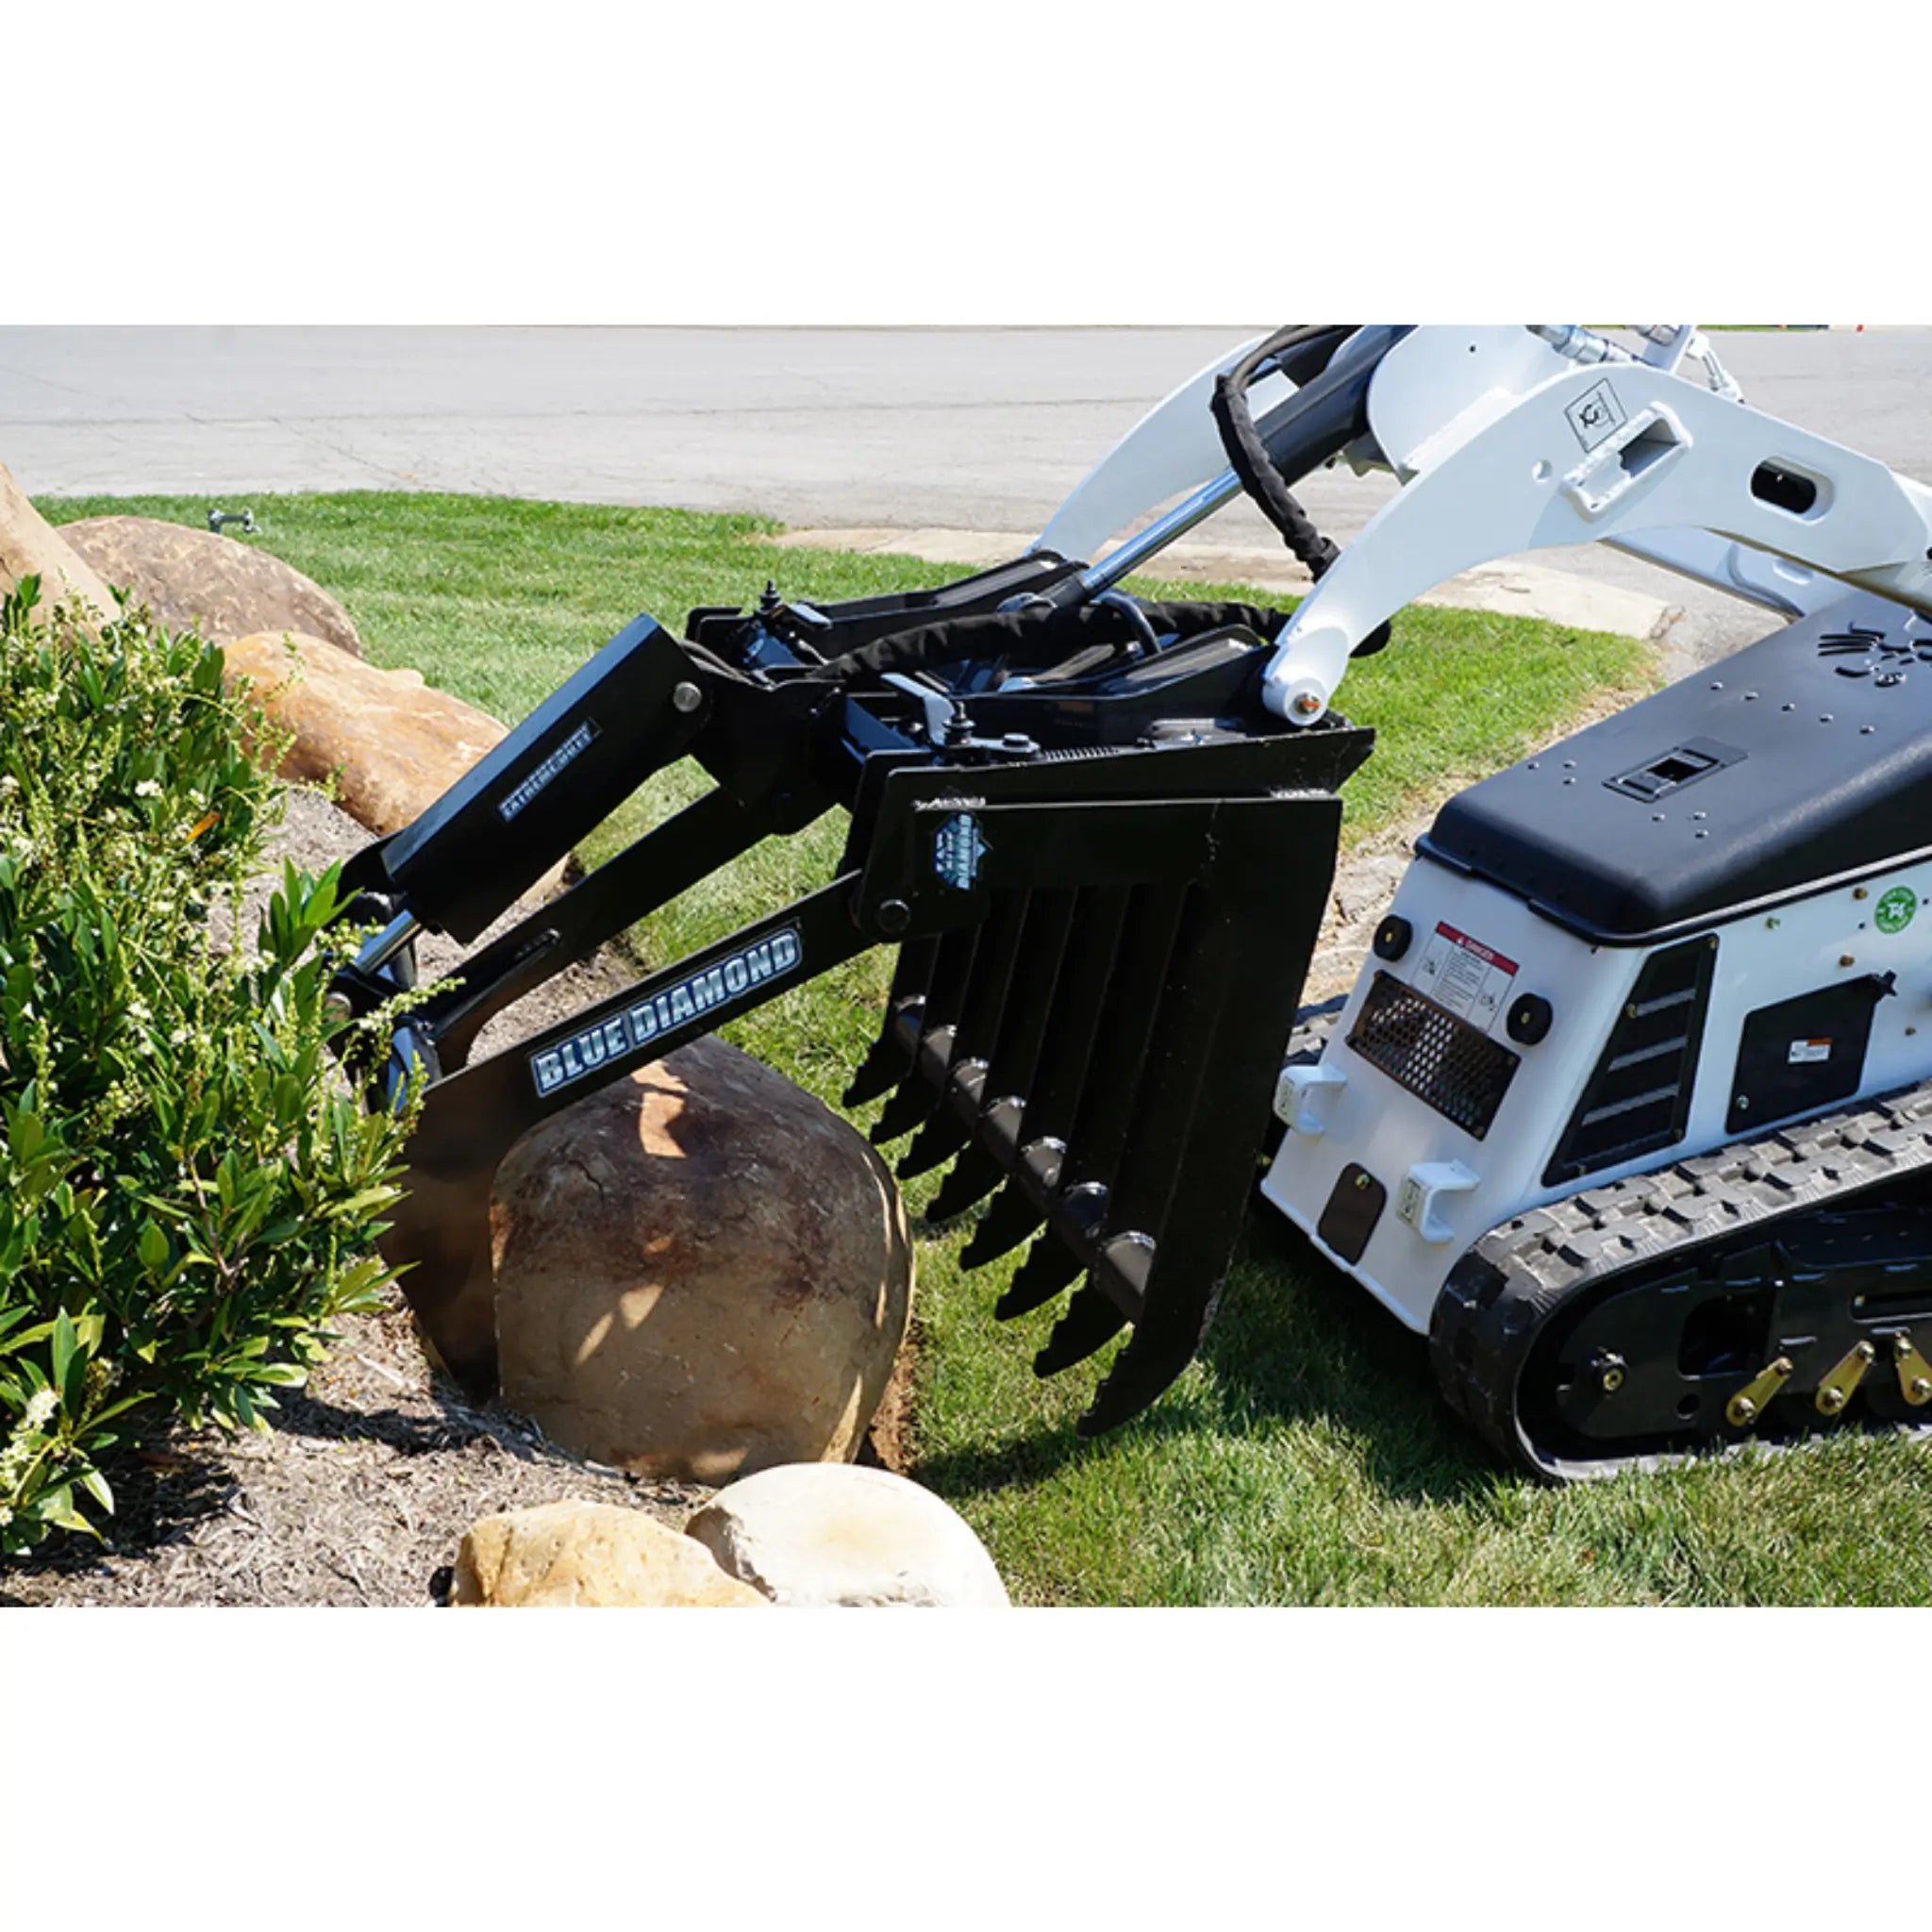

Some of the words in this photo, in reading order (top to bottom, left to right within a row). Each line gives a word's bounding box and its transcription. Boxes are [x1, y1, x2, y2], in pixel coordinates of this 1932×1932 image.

[957, 813, 972, 891] DIAMOND
[535, 1017, 628, 1090] BLUE
[629, 931, 798, 1041] DIAMOND
